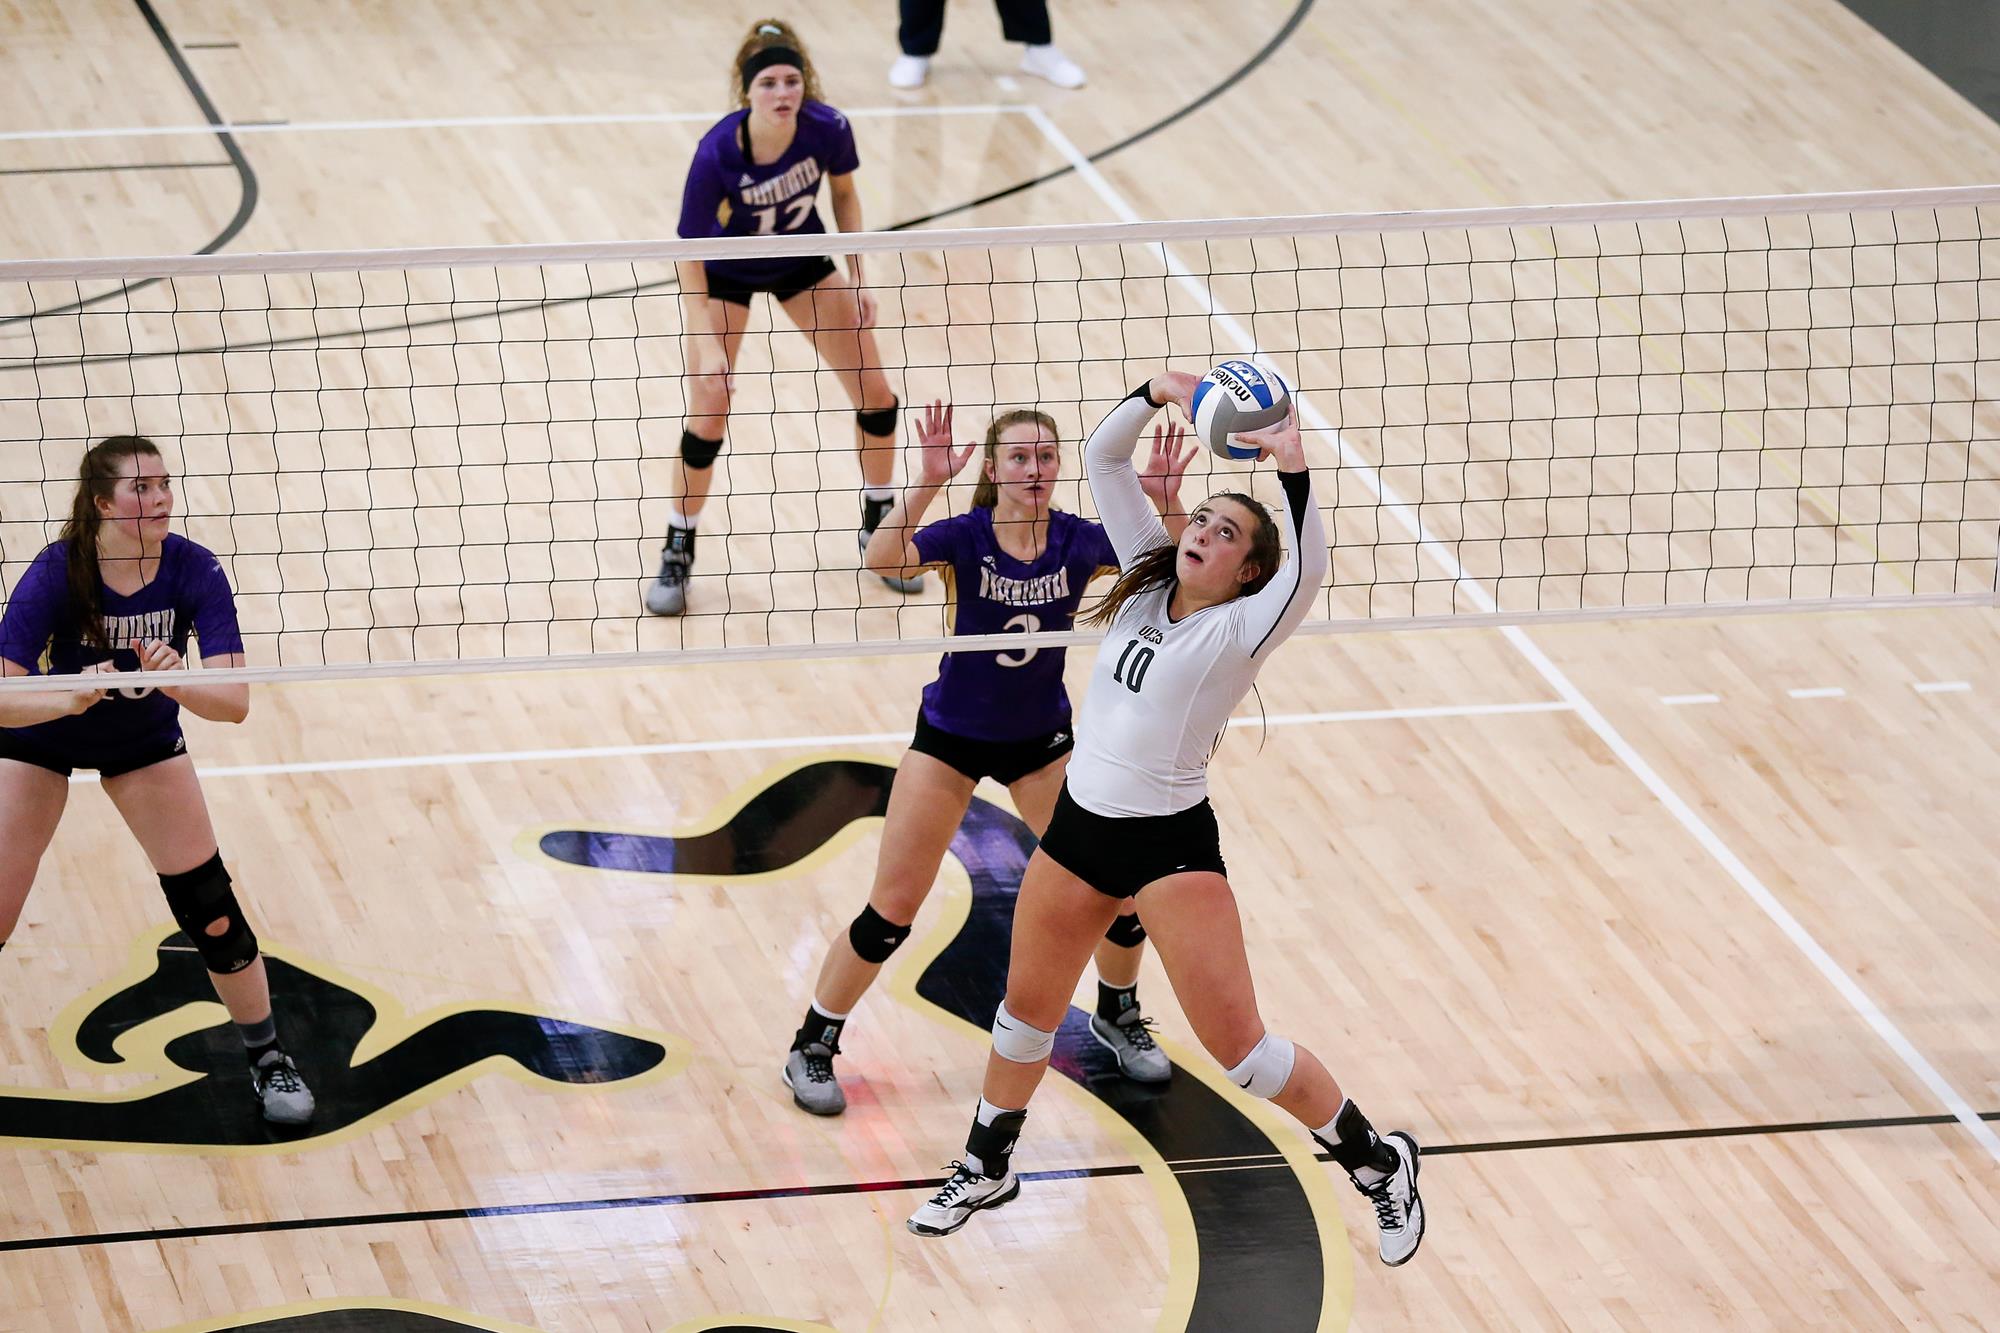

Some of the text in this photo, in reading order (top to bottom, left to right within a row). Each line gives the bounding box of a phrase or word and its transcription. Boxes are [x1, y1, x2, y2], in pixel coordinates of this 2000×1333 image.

[1211, 368, 1251, 401] molten
[996, 614, 1040, 667] 3
[1113, 640, 1155, 693] 10
